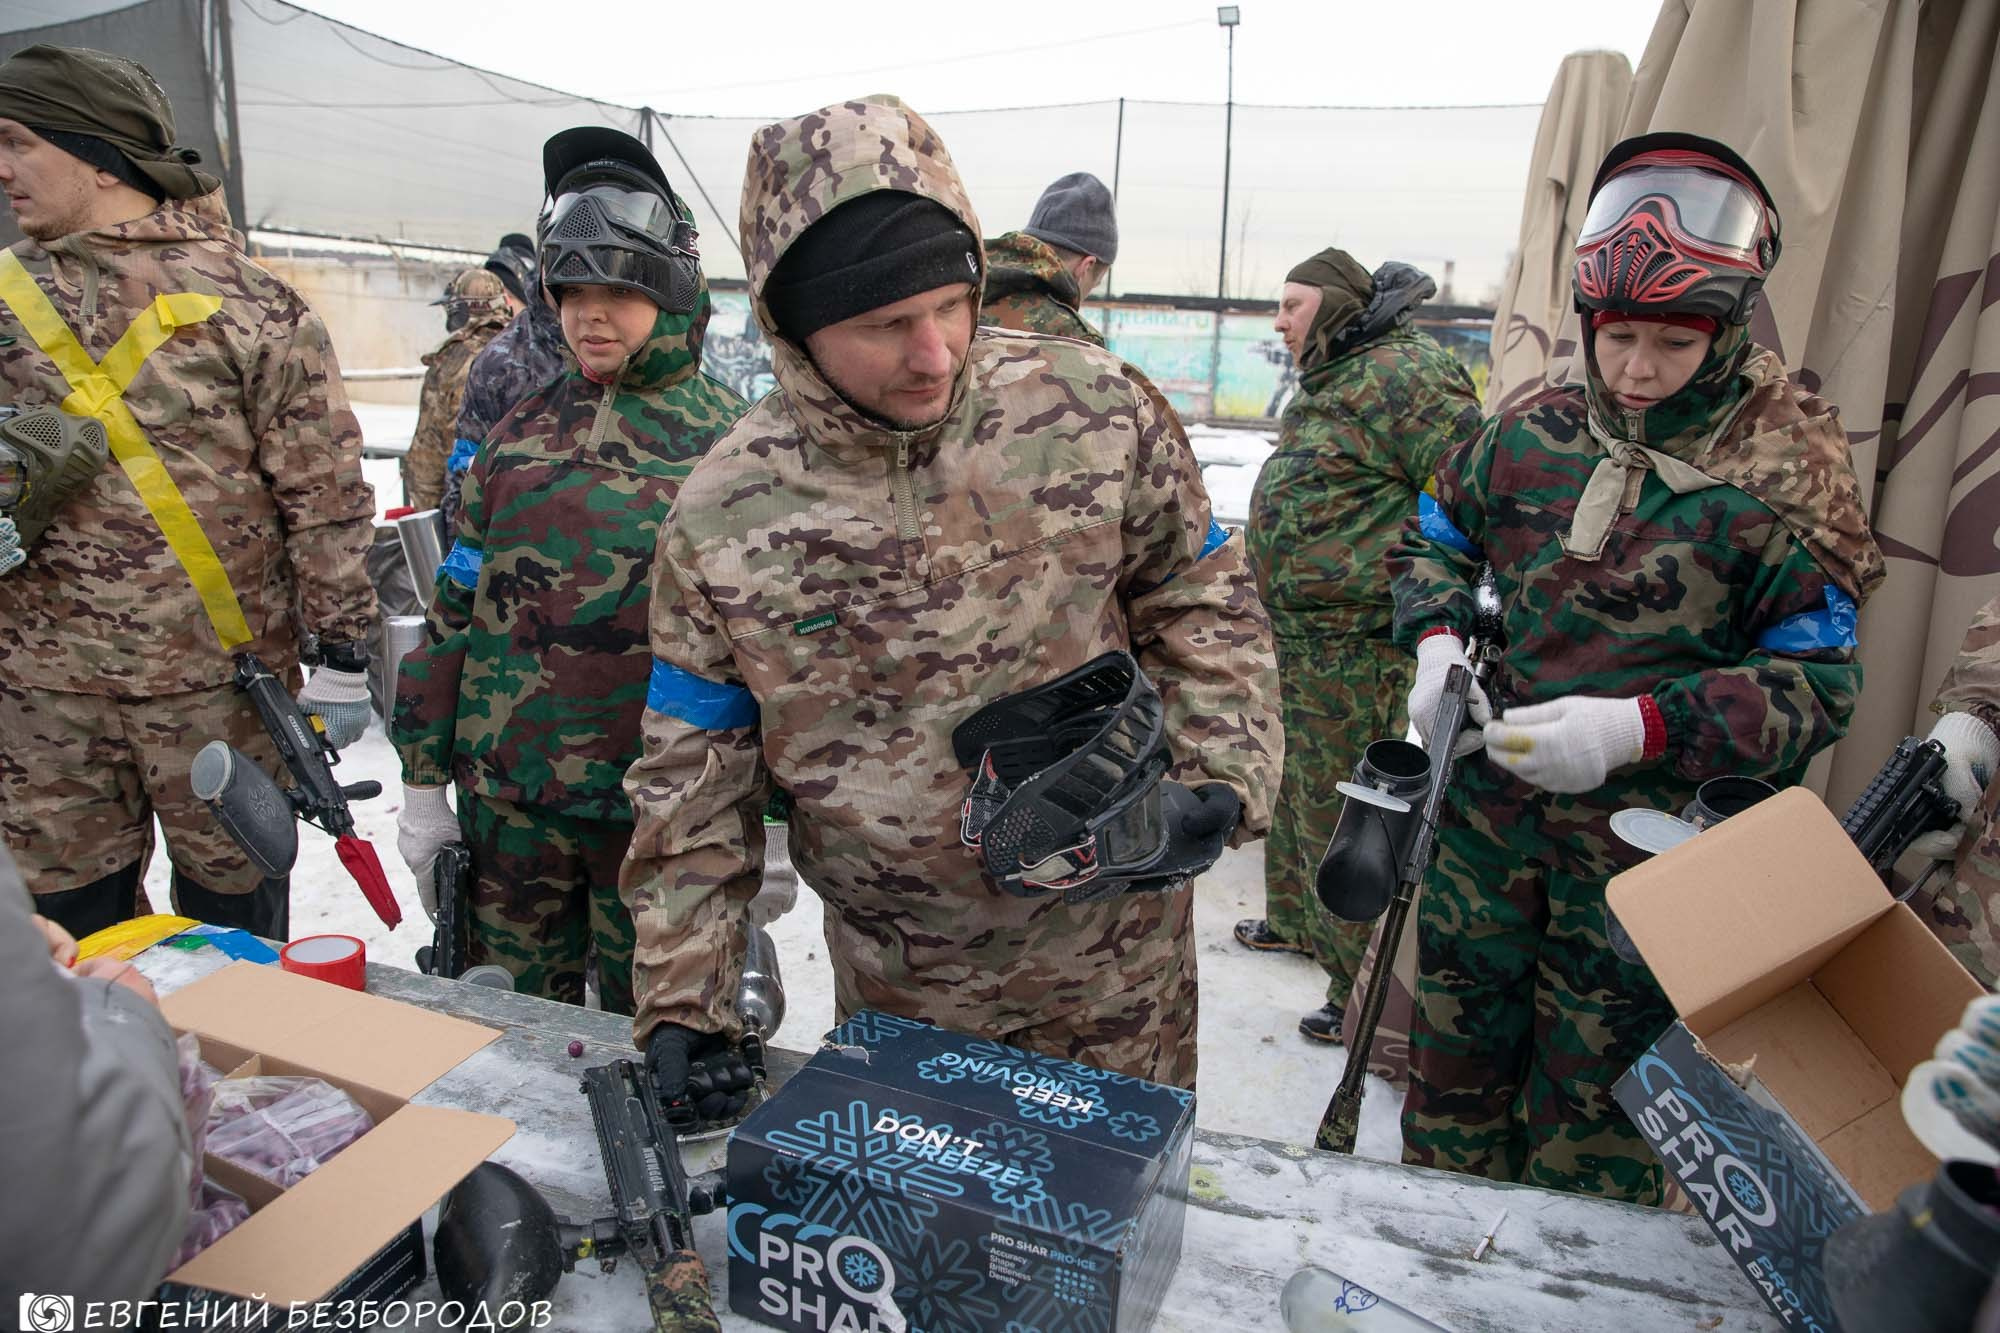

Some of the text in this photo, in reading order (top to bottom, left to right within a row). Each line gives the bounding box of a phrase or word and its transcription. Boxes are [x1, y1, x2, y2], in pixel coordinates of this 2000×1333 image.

[940, 1053, 1066, 1094] MOVING
[1012, 1085, 1094, 1113] KEEP
[873, 1116, 983, 1157] DON'T
[896, 1138, 1024, 1186] FREEZE
[1654, 1088, 1777, 1227] PRO
[1637, 1106, 1753, 1255] SHAR
[990, 1232, 1015, 1246] PRO
[1016, 1240, 1048, 1257] SHAR
[990, 1247, 1027, 1265] Accuracy
[990, 1255, 1016, 1269] Shape
[759, 1231, 895, 1304] PRO
[988, 1270, 1019, 1287] Density
[989, 1262, 1032, 1281] Brittleness
[1746, 1260, 1792, 1324] BALL
